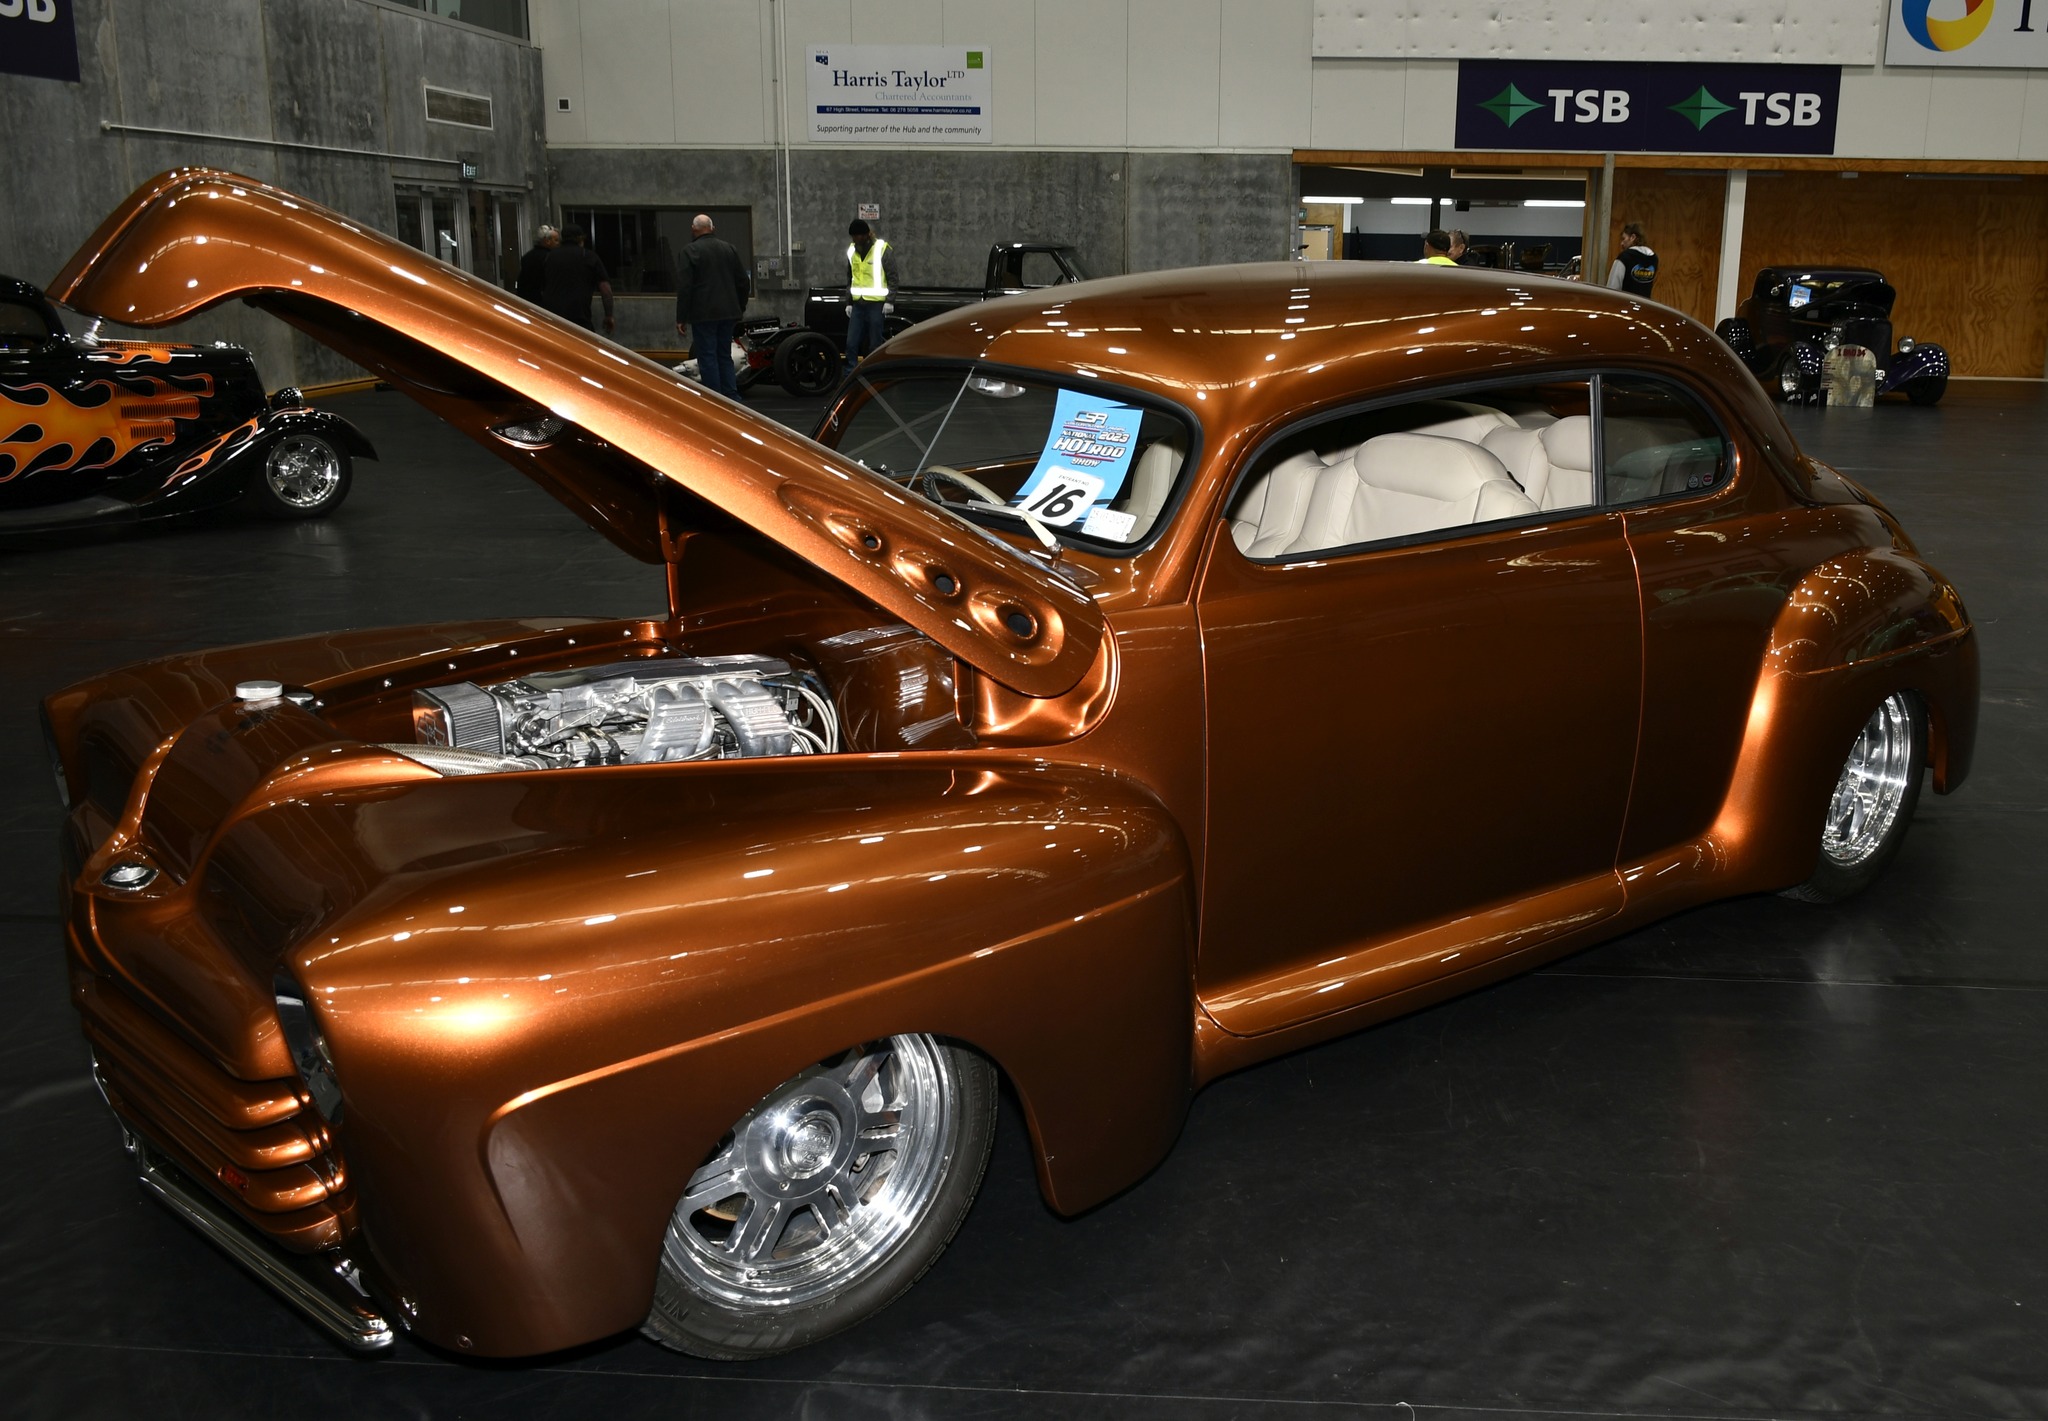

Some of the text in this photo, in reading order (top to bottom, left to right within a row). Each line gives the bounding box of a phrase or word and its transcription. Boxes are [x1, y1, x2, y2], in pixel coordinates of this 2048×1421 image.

[832, 69, 965, 92] Harris Taylor LTD
[875, 91, 972, 101] Chartered Accountants
[1548, 88, 1630, 123] TSB
[1739, 91, 1822, 127] TSB
[816, 124, 982, 136] Supporting partner of the Hub and the community
[1061, 429, 1131, 444] NATIONAL 2023
[1070, 457, 1102, 467] SHOW
[1027, 483, 1086, 518] 16
